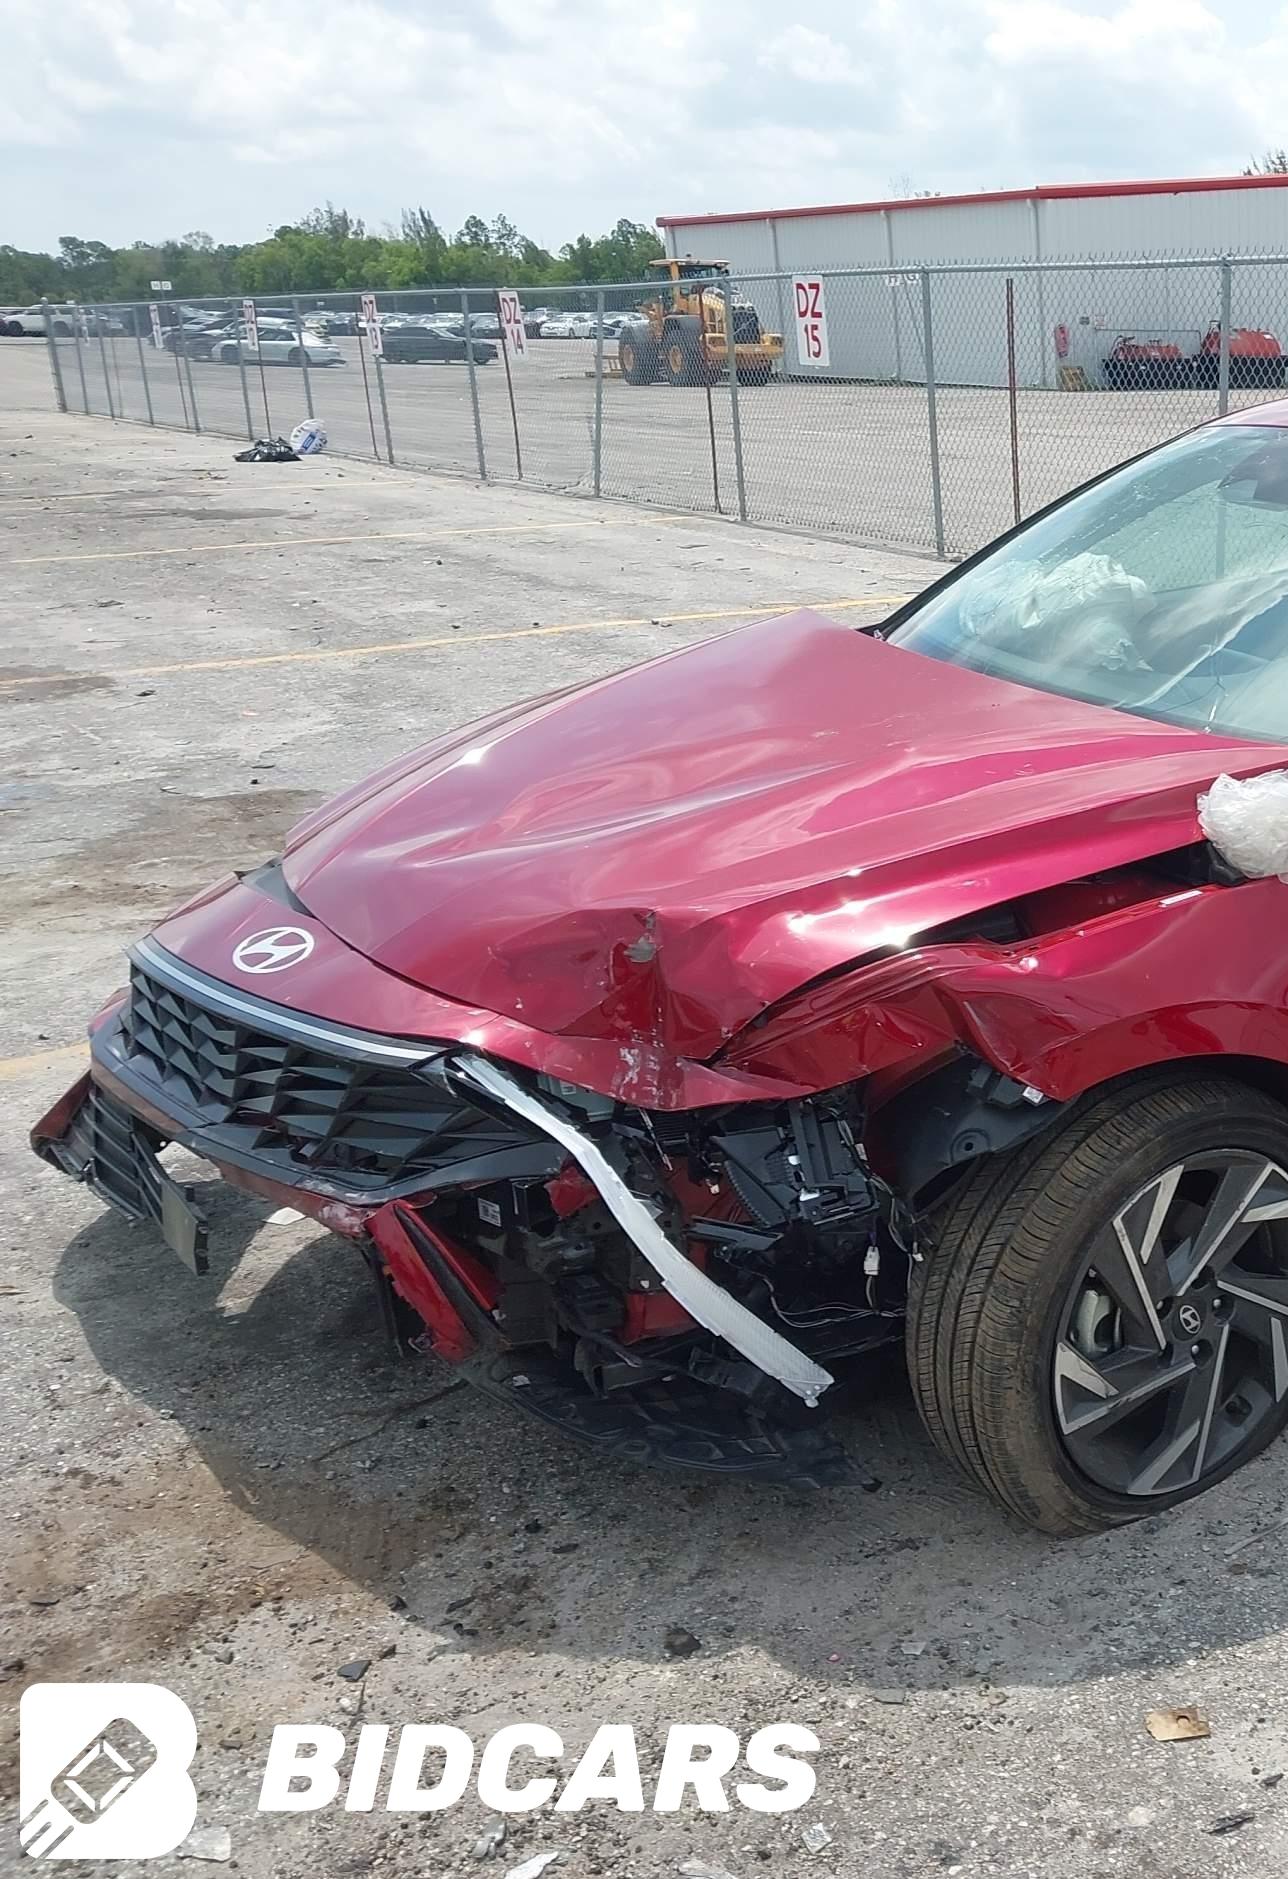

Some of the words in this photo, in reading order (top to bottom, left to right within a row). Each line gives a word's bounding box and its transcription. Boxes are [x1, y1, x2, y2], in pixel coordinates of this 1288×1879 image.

[501, 297, 521, 324] DZ
[795, 282, 823, 318] DZ
[511, 328, 524, 354] 14
[804, 323, 822, 358] 15
